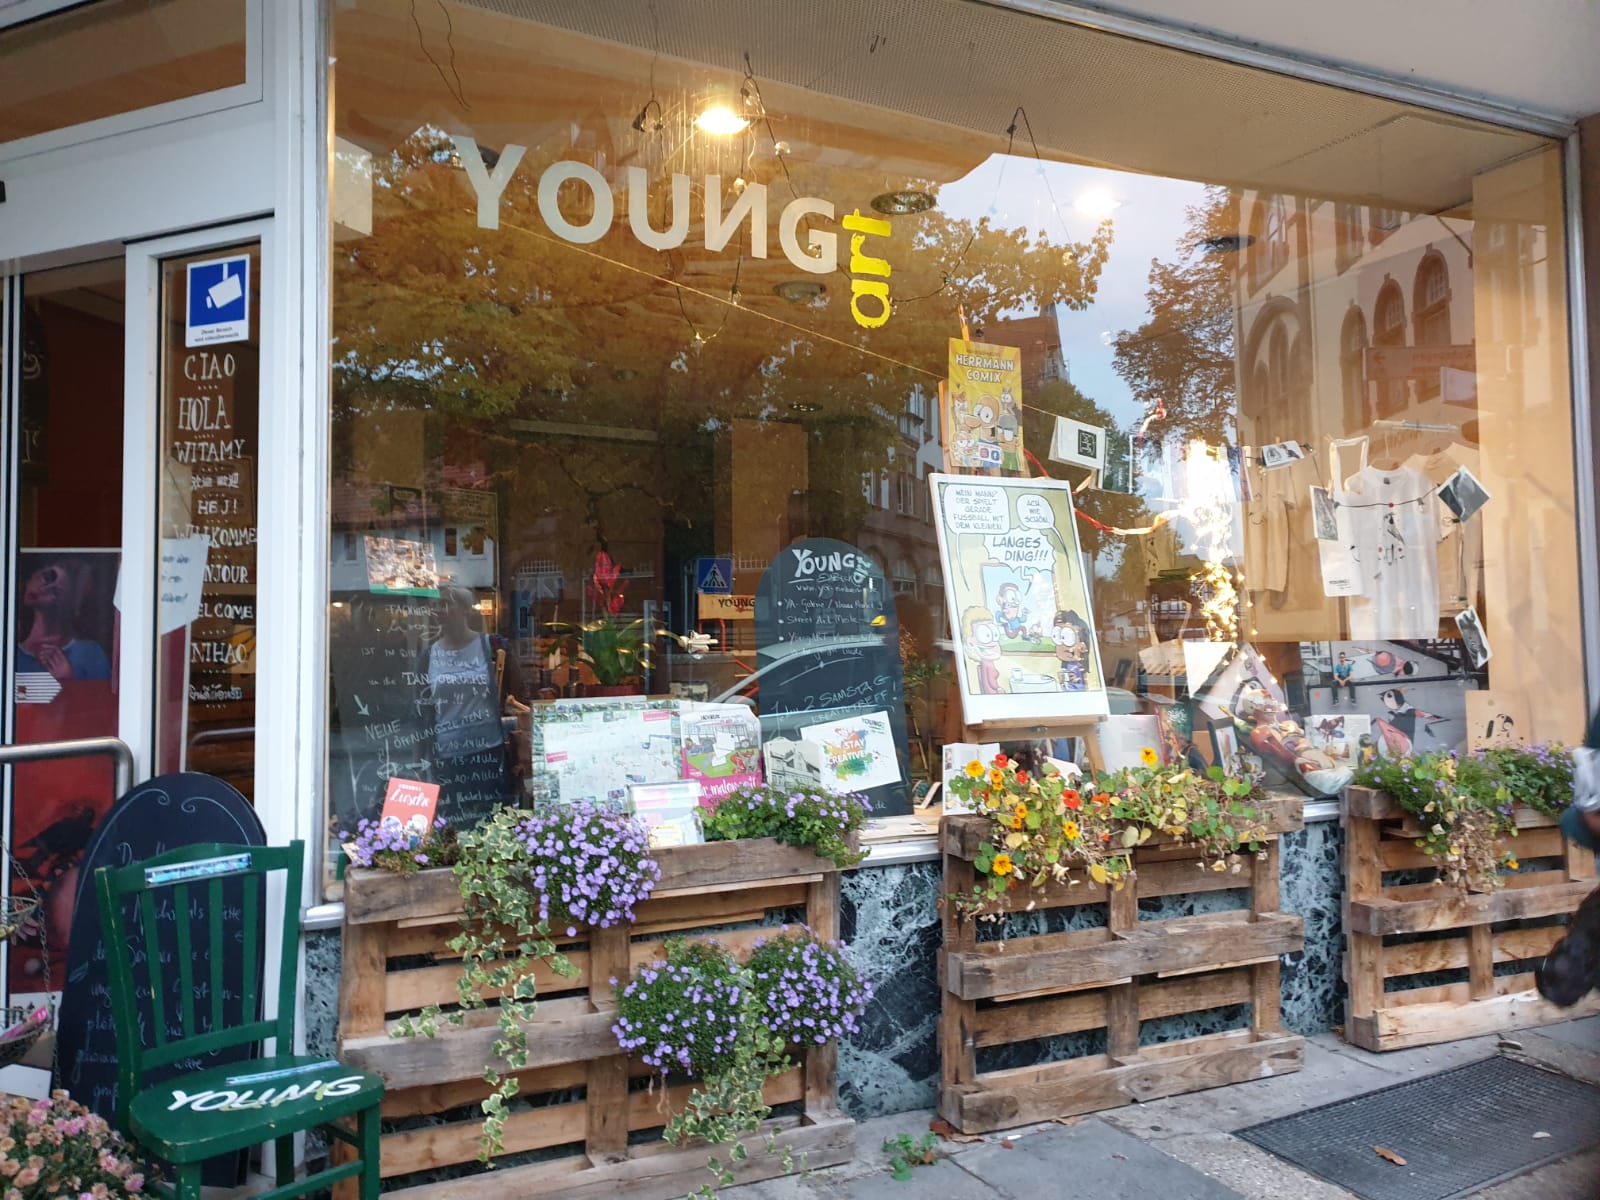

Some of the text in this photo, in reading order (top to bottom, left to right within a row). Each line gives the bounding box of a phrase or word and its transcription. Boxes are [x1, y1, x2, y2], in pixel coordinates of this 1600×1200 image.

[842, 208, 892, 329] art
[184, 351, 236, 381] CIAO
[955, 353, 1015, 371] HERRMANN
[966, 368, 1002, 384] COMIX
[178, 394, 232, 432] HOLA
[174, 438, 246, 464] WITAMY
[197, 498, 238, 515] HEJ!
[992, 535, 1041, 549] LANGES
[791, 548, 856, 578] YOUNG
[1004, 549, 1049, 562] DING!!!
[197, 602, 254, 620] ELCOME
[819, 675, 890, 708] SAMSTAG
[364, 719, 401, 742] NEUE
[167, 1075, 365, 1112] YOUNG
